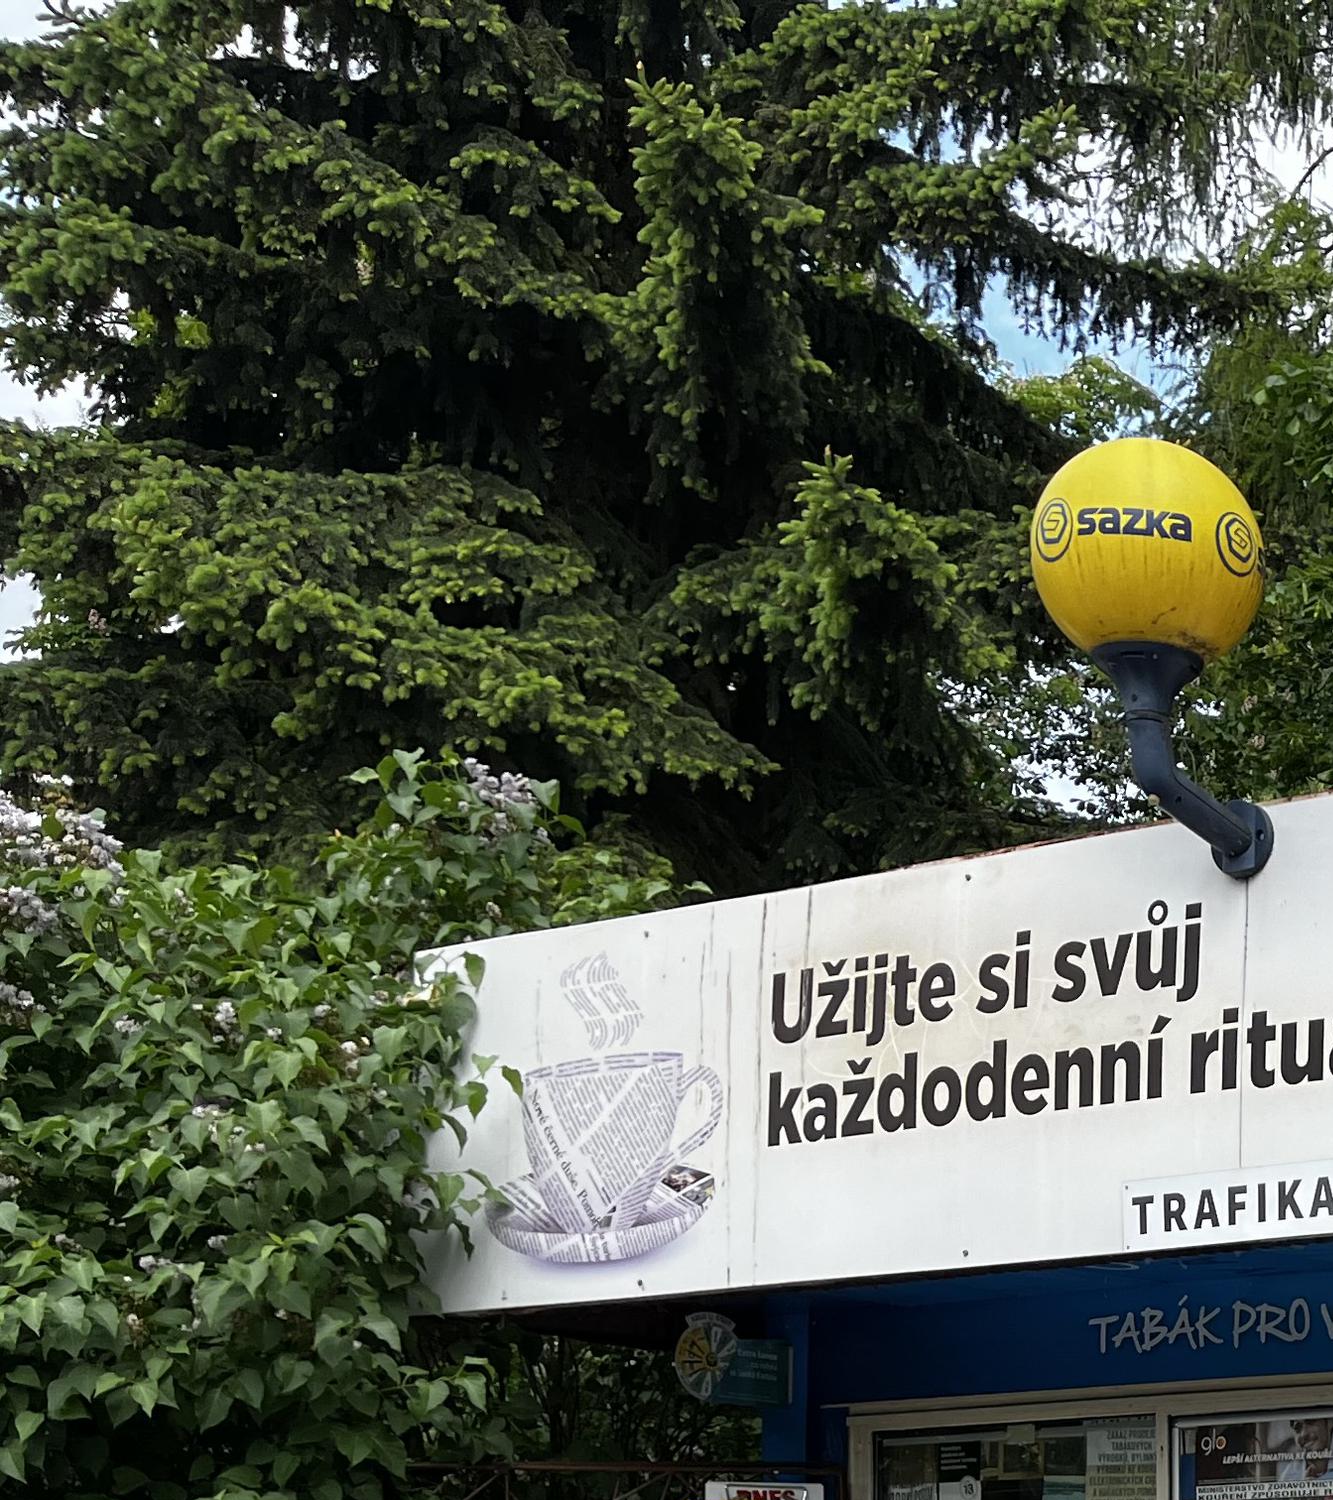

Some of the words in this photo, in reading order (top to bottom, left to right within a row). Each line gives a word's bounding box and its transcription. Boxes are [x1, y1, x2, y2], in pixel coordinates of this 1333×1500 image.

[770, 953, 956, 1047] Užijte
[976, 930, 1031, 1014] si
[1051, 900, 1202, 1003] svůj
[767, 1015, 1172, 1148] každodenní
[1089, 1295, 1223, 1354] TABÁK
[1232, 1298, 1310, 1348] PRO
[1201, 1428, 1226, 1456] glo
[1222, 1454, 1243, 1464] LEPŠÍ
[1245, 1452, 1294, 1463] ALTERNATIVA
[1198, 1484, 1265, 1494] MINISTERSTVO
